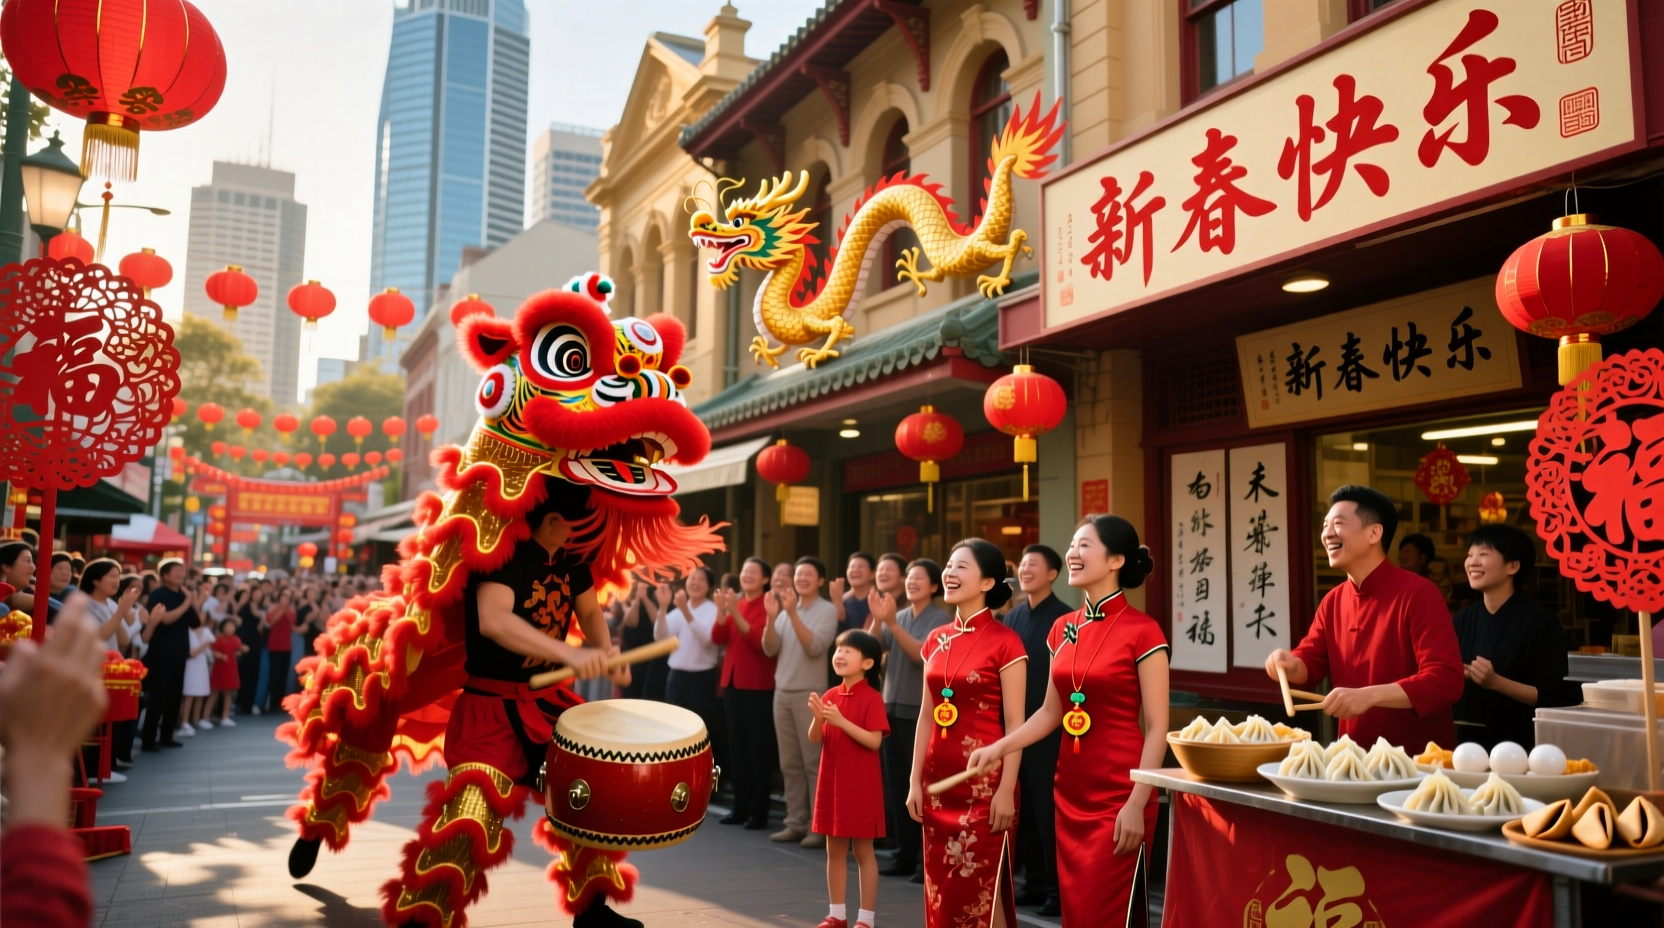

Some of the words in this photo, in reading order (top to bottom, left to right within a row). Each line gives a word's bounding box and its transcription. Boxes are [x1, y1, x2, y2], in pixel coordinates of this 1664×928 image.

[1080, 8, 1541, 288] 新春快乐
[1284, 305, 1492, 401] 新春快乐
